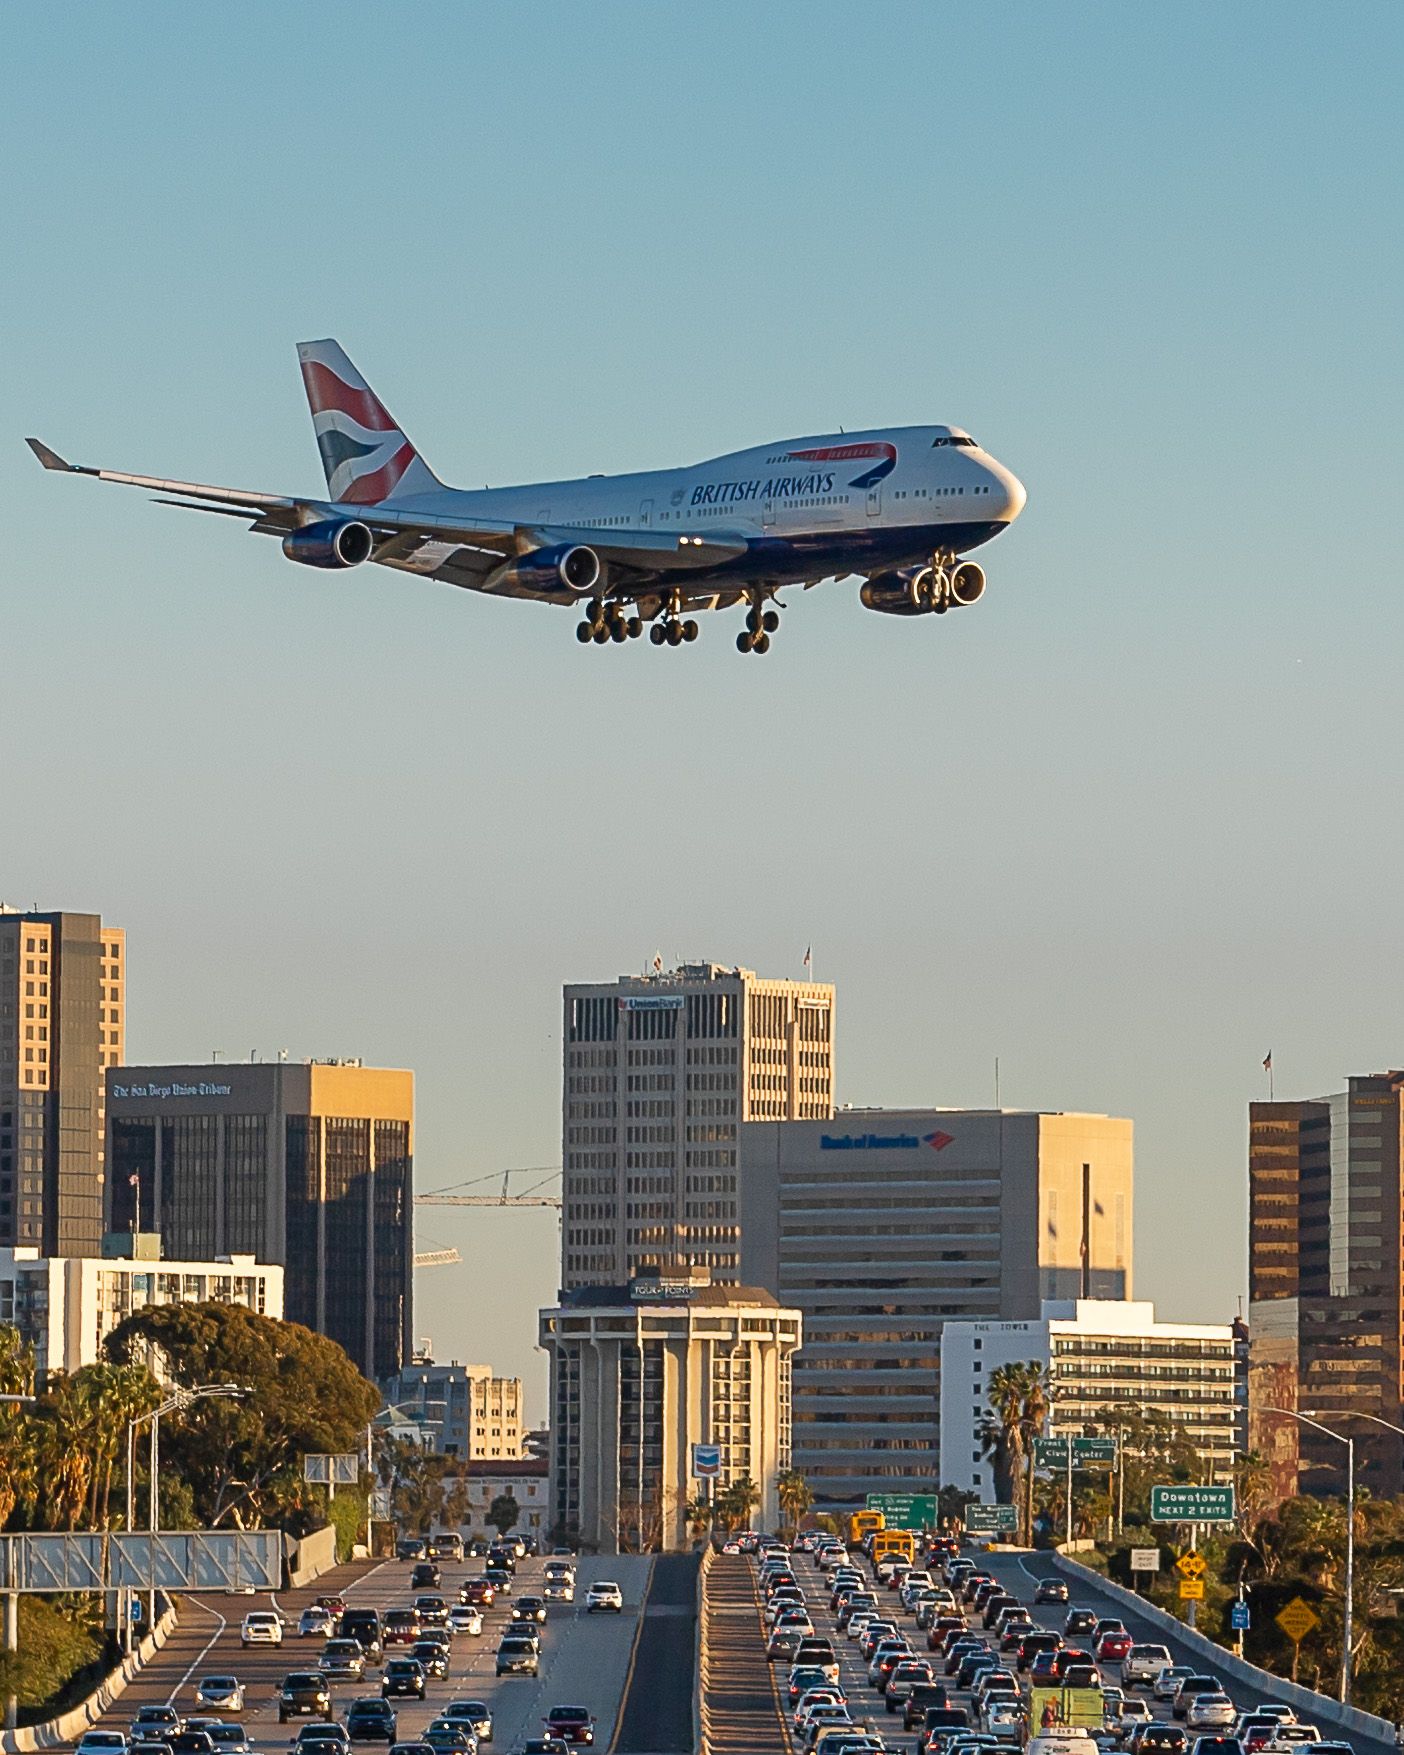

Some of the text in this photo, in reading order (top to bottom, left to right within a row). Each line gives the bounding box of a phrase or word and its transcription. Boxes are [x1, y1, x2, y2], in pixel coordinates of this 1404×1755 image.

[690, 472, 837, 506] BRITISH AIRWAYS
[1160, 1491, 1226, 1502] Downtown
[1159, 1506, 1227, 1515] NEXT 2 EXITS
